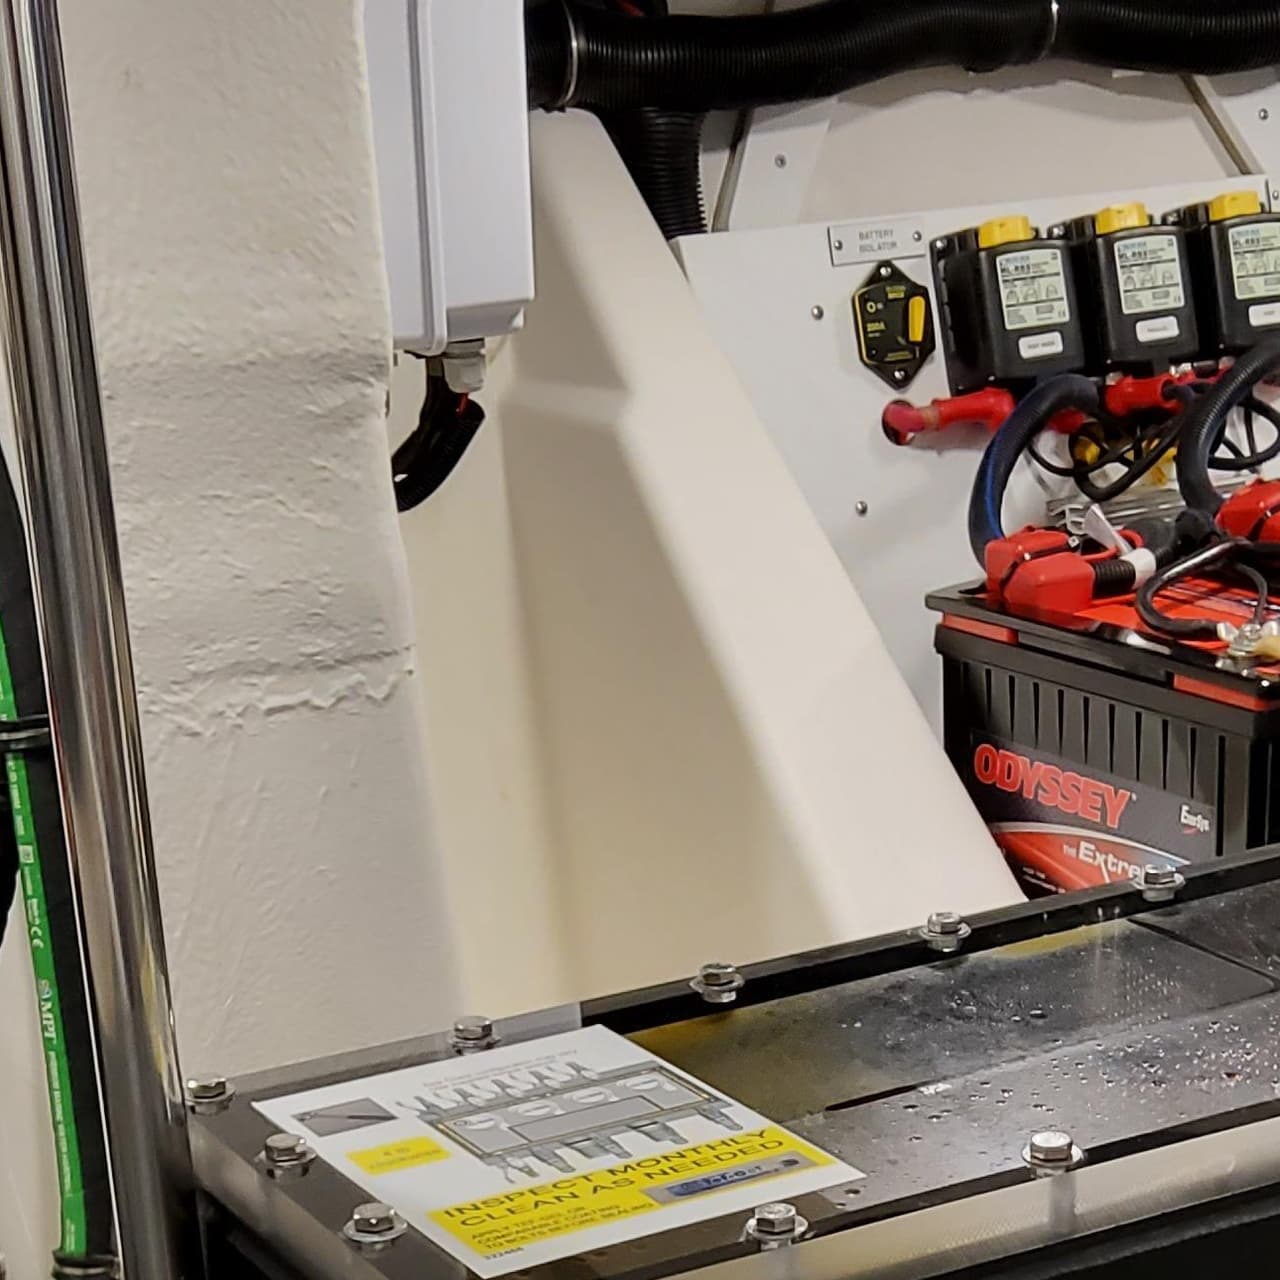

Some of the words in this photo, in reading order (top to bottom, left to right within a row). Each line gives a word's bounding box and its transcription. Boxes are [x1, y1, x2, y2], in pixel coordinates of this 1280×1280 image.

[858, 229, 894, 241] BATTERY
[859, 241, 897, 253] ISOLATOR
[974, 743, 1131, 829] ODYSSEY
[40, 1001, 57, 1044] MPI
[444, 1173, 593, 1218] INSPECT
[607, 1129, 769, 1177] MONTHLY
[460, 1190, 581, 1227] CLEAN
[592, 1177, 636, 1195] AS
[644, 1139, 786, 1180] NEEDED
